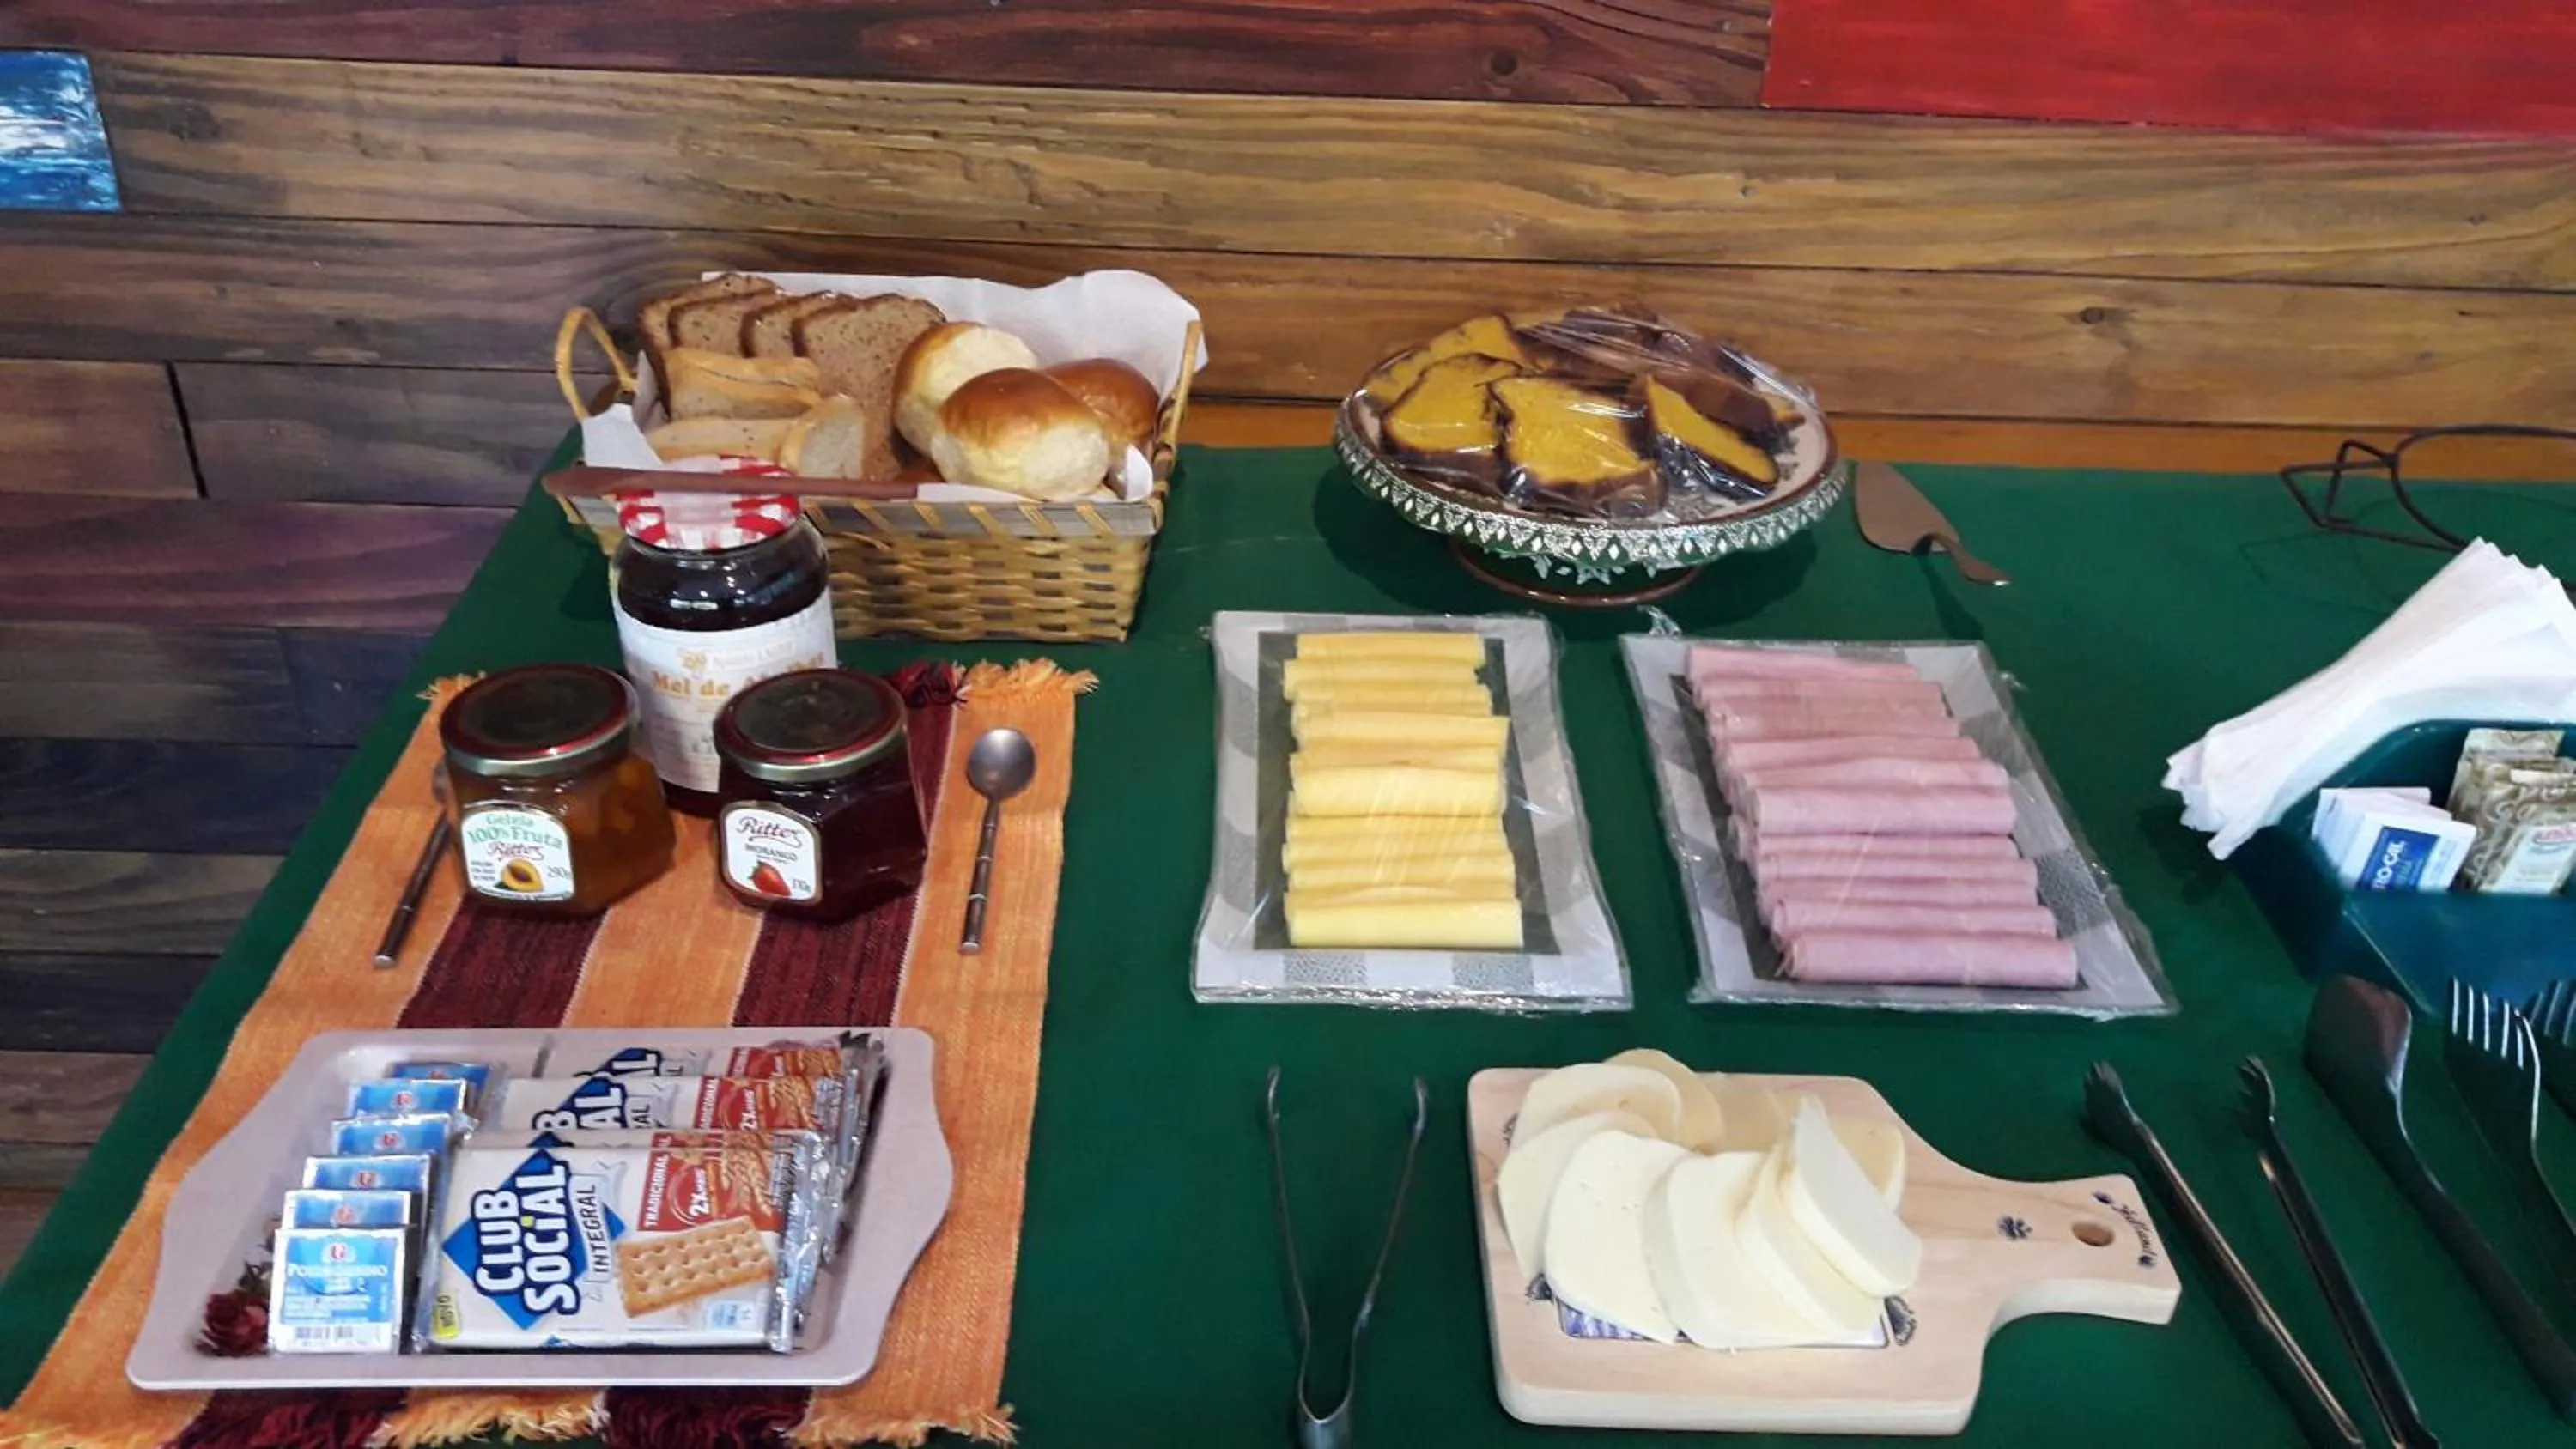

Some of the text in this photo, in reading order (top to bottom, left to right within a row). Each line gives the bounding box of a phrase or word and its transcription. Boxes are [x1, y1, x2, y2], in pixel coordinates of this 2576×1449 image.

[512, 826, 563, 849] Fruta
[515, 1155, 578, 1313] SOCIAL
[576, 1185, 611, 1273] INTEGRAL
[643, 1153, 670, 1228] TRADICIONAL
[473, 1190, 526, 1292] CLUB
